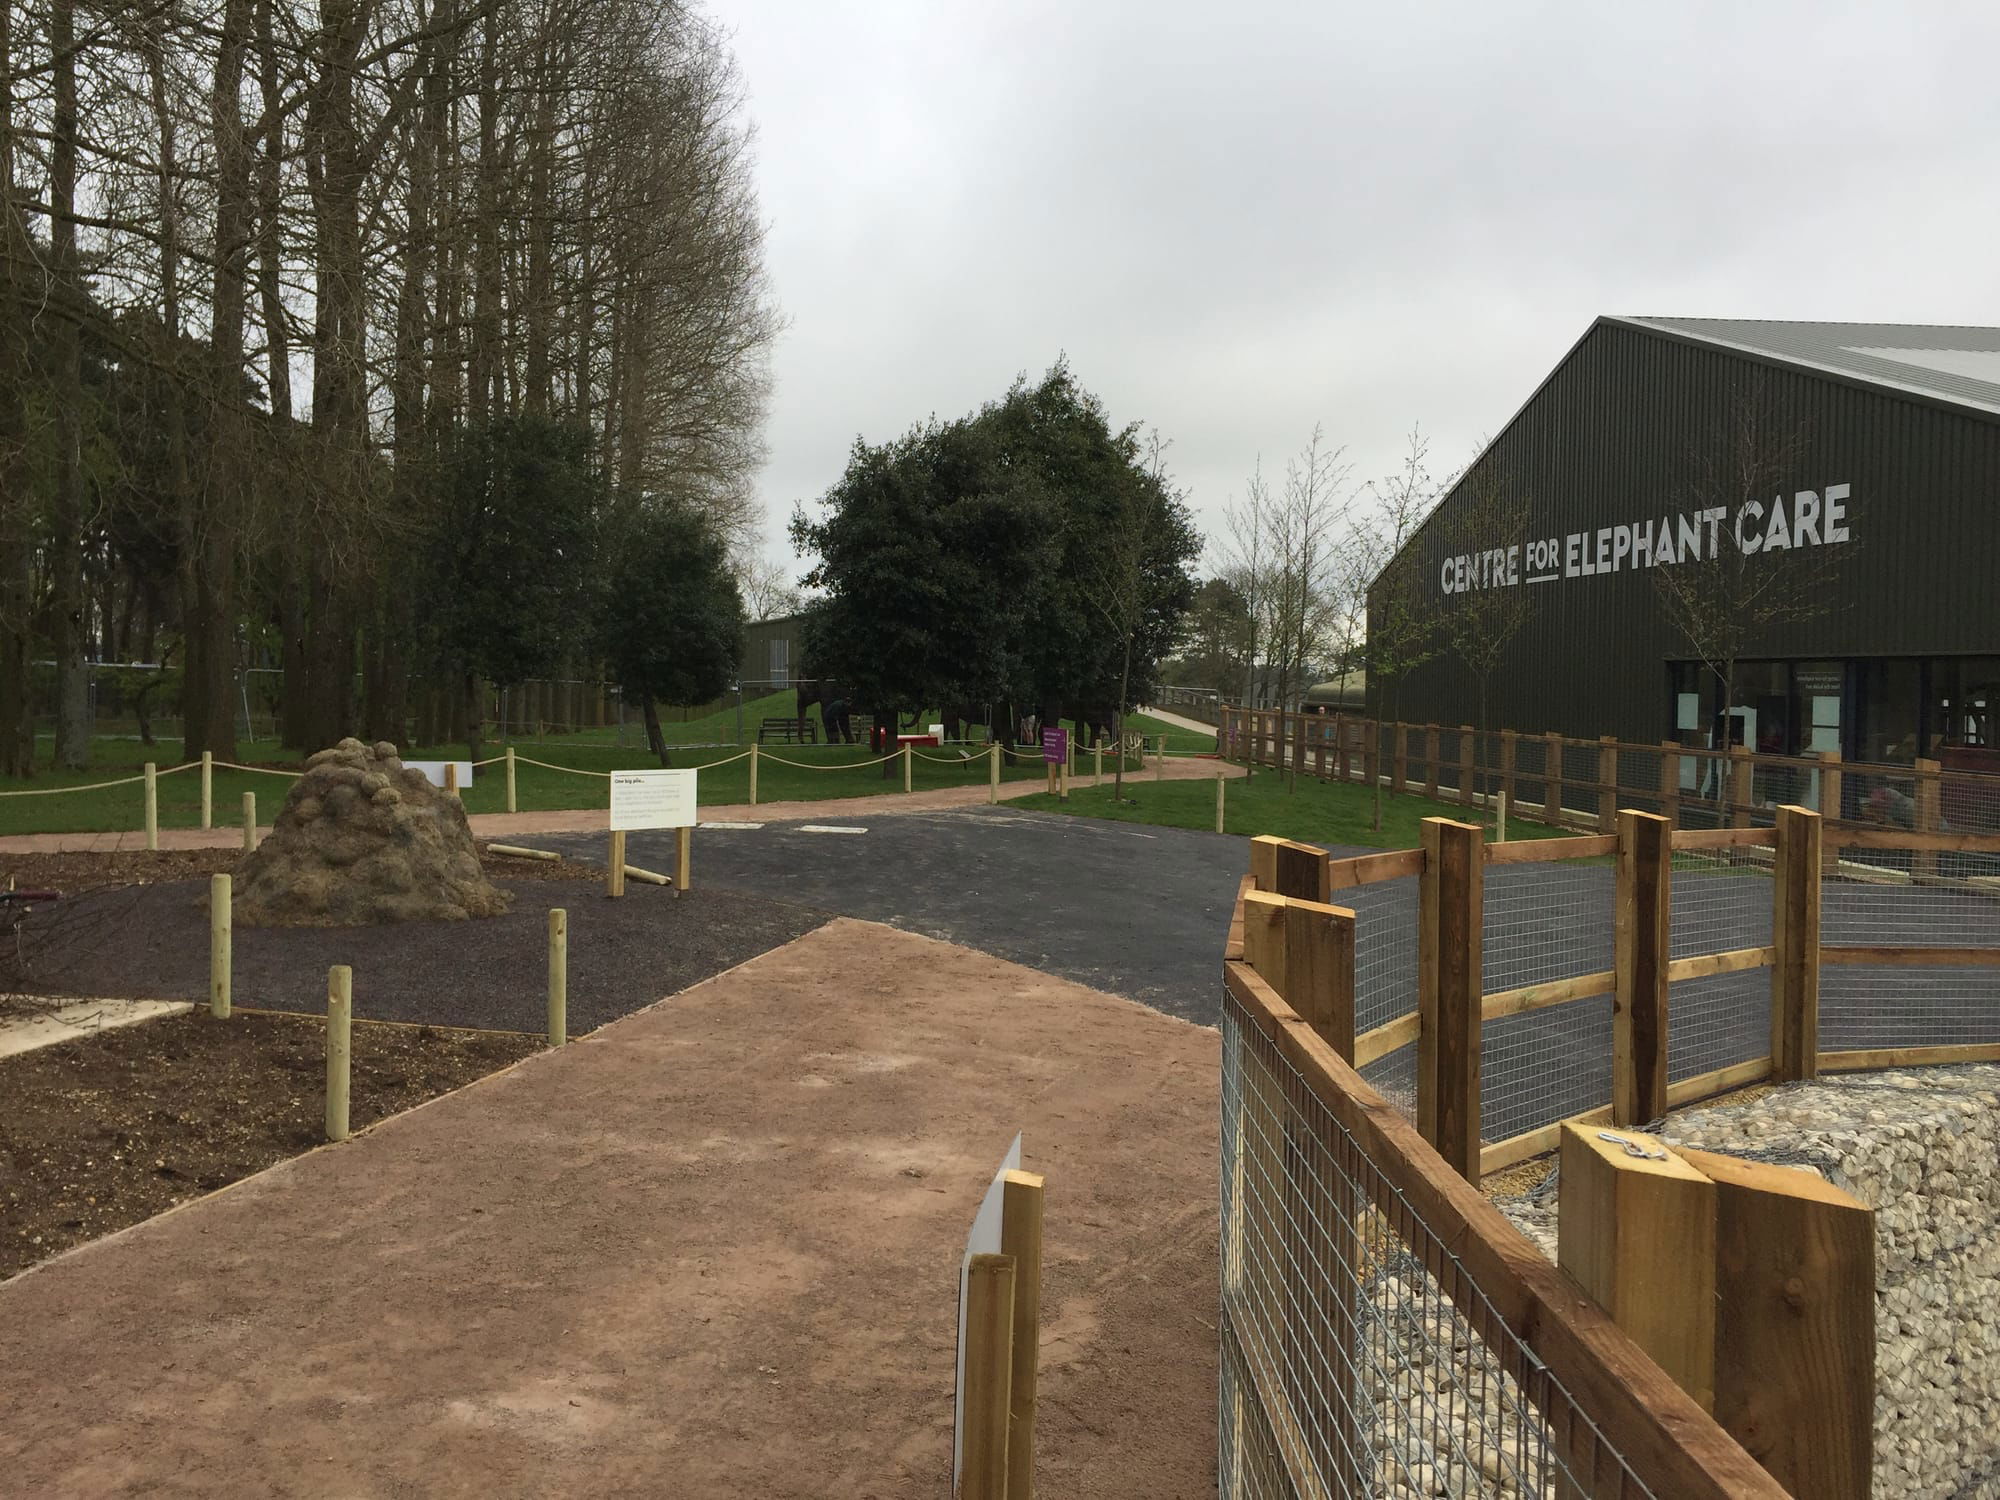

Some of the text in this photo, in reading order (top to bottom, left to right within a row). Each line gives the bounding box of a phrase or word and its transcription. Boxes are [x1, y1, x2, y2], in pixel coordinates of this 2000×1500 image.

[1441, 483, 1850, 594] CENTRE FOR ELEPHANT CARE
